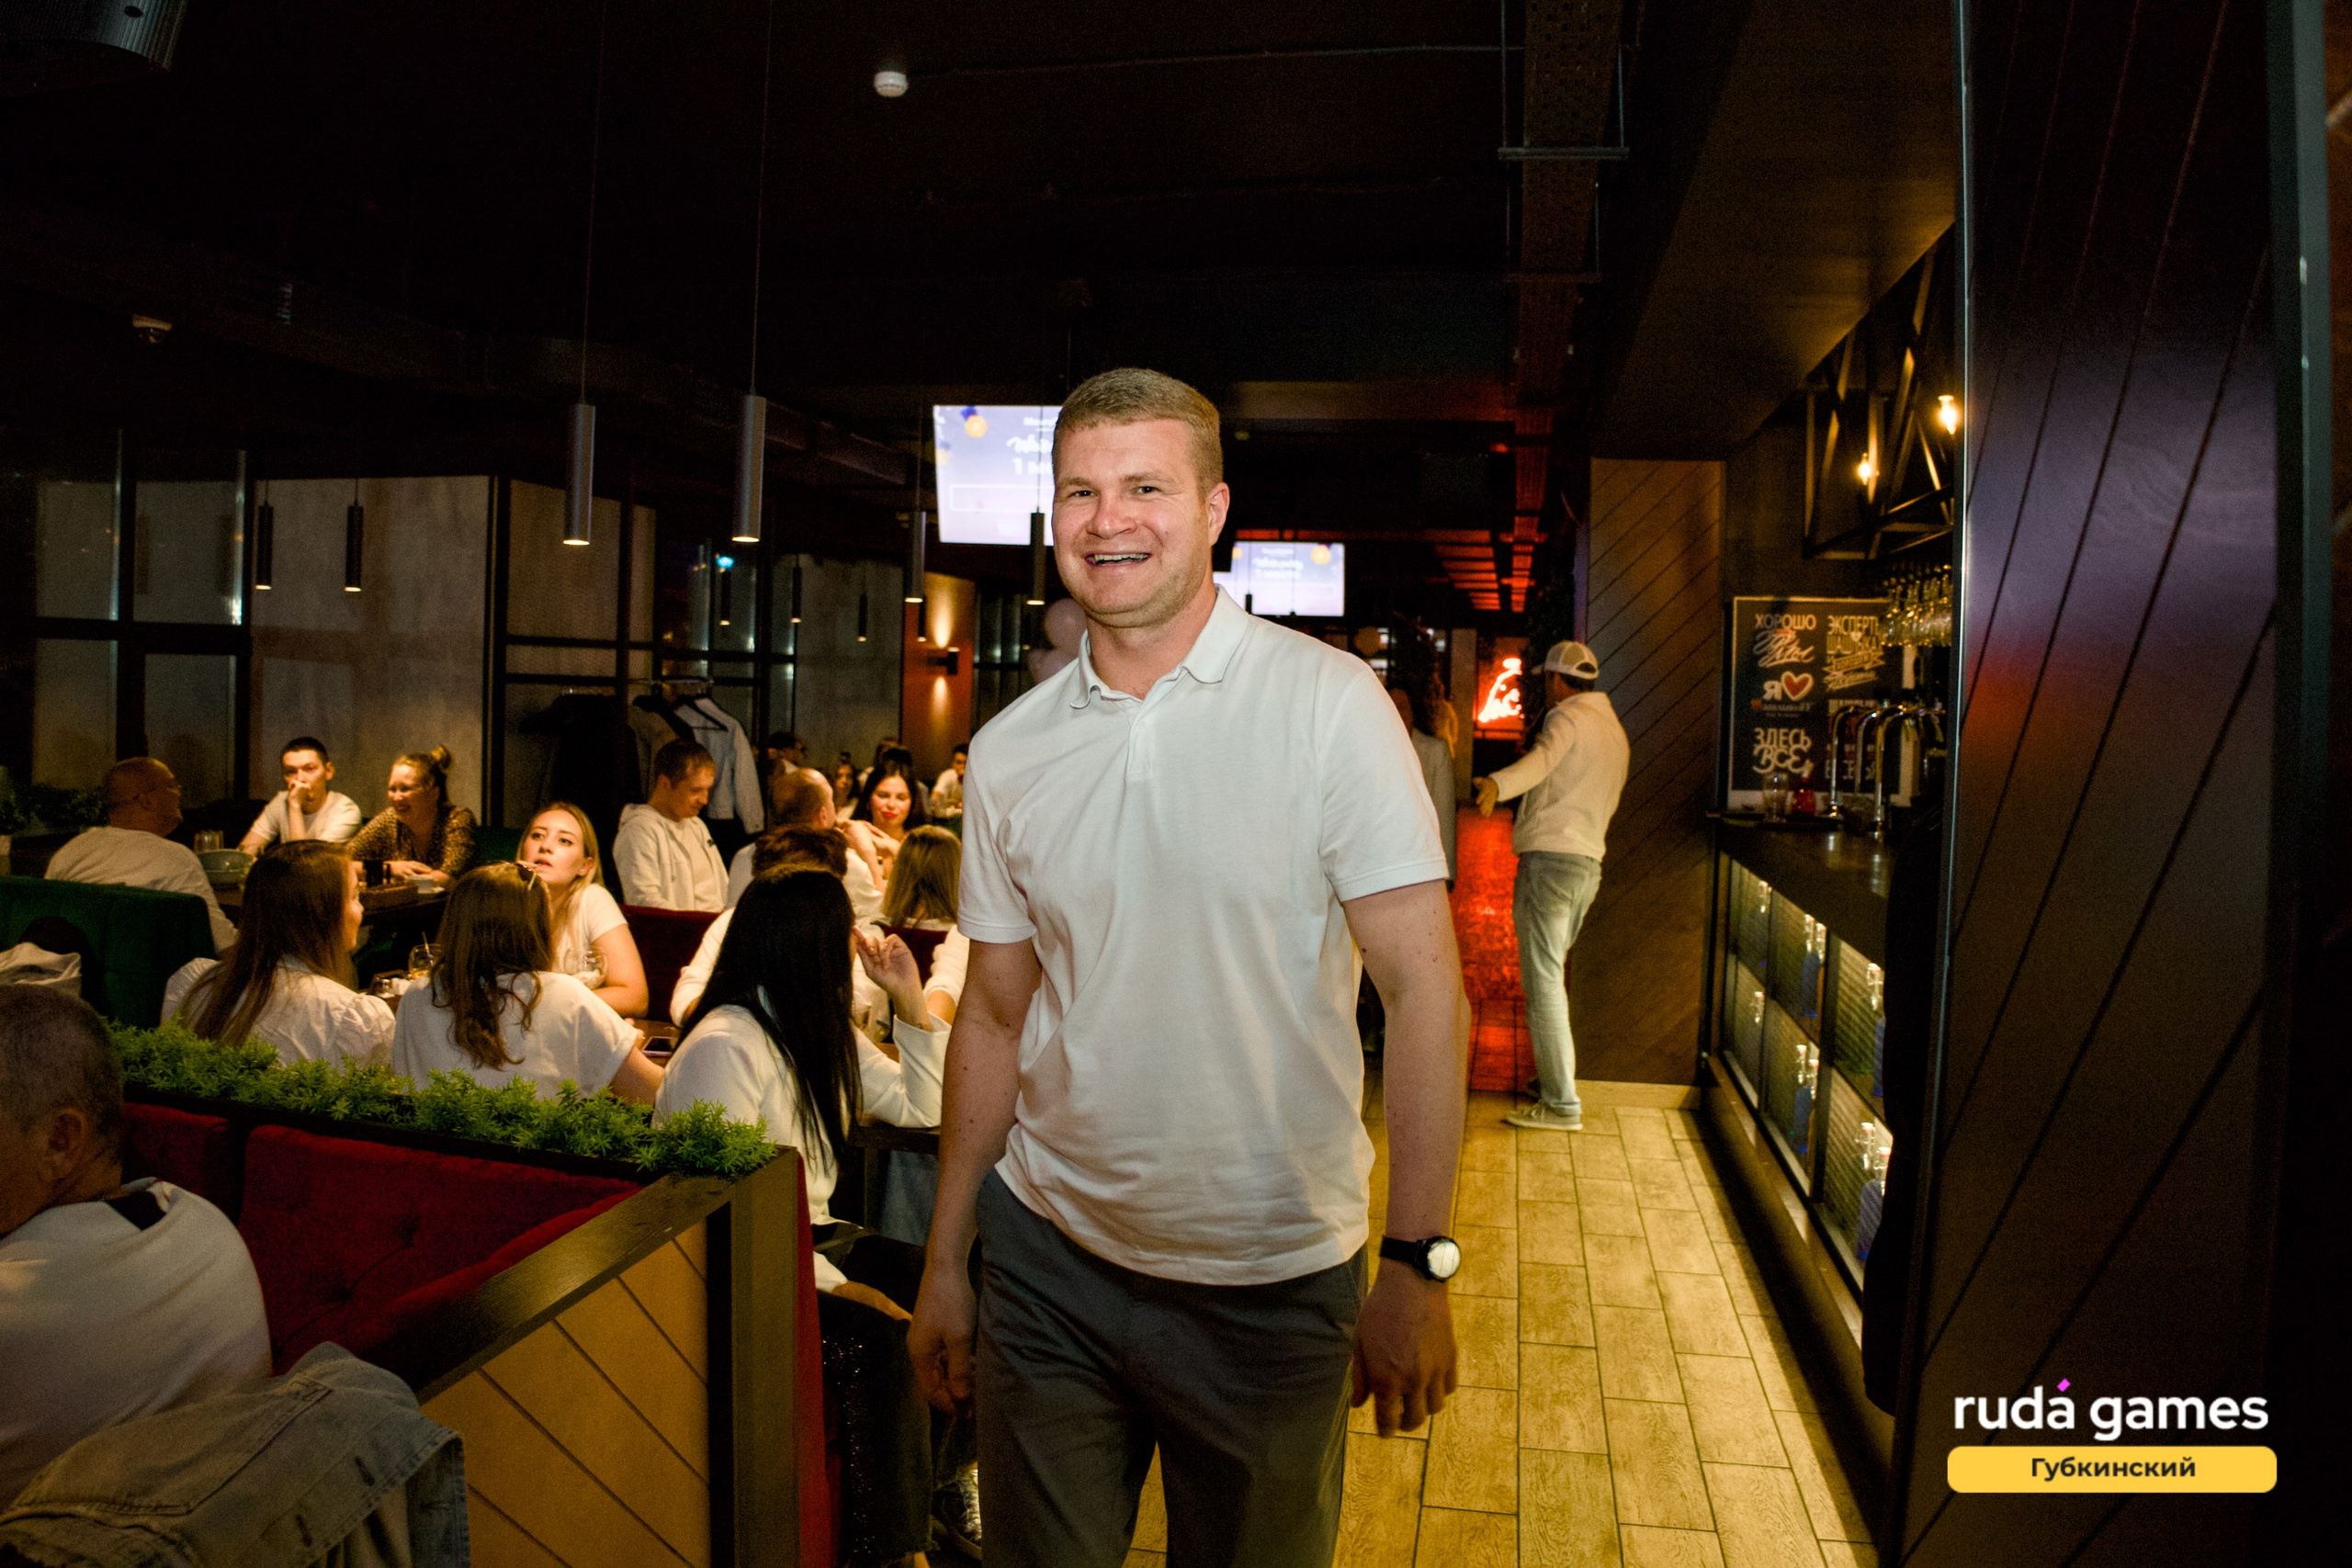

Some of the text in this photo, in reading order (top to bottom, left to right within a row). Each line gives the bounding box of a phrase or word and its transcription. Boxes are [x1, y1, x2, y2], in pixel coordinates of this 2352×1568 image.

[1755, 614, 1816, 630] ХОРОШО
[1763, 681, 1782, 700] Я
[1754, 728, 1812, 749] ЗДЕСЬ
[1752, 744, 1811, 773] ВСЕ
